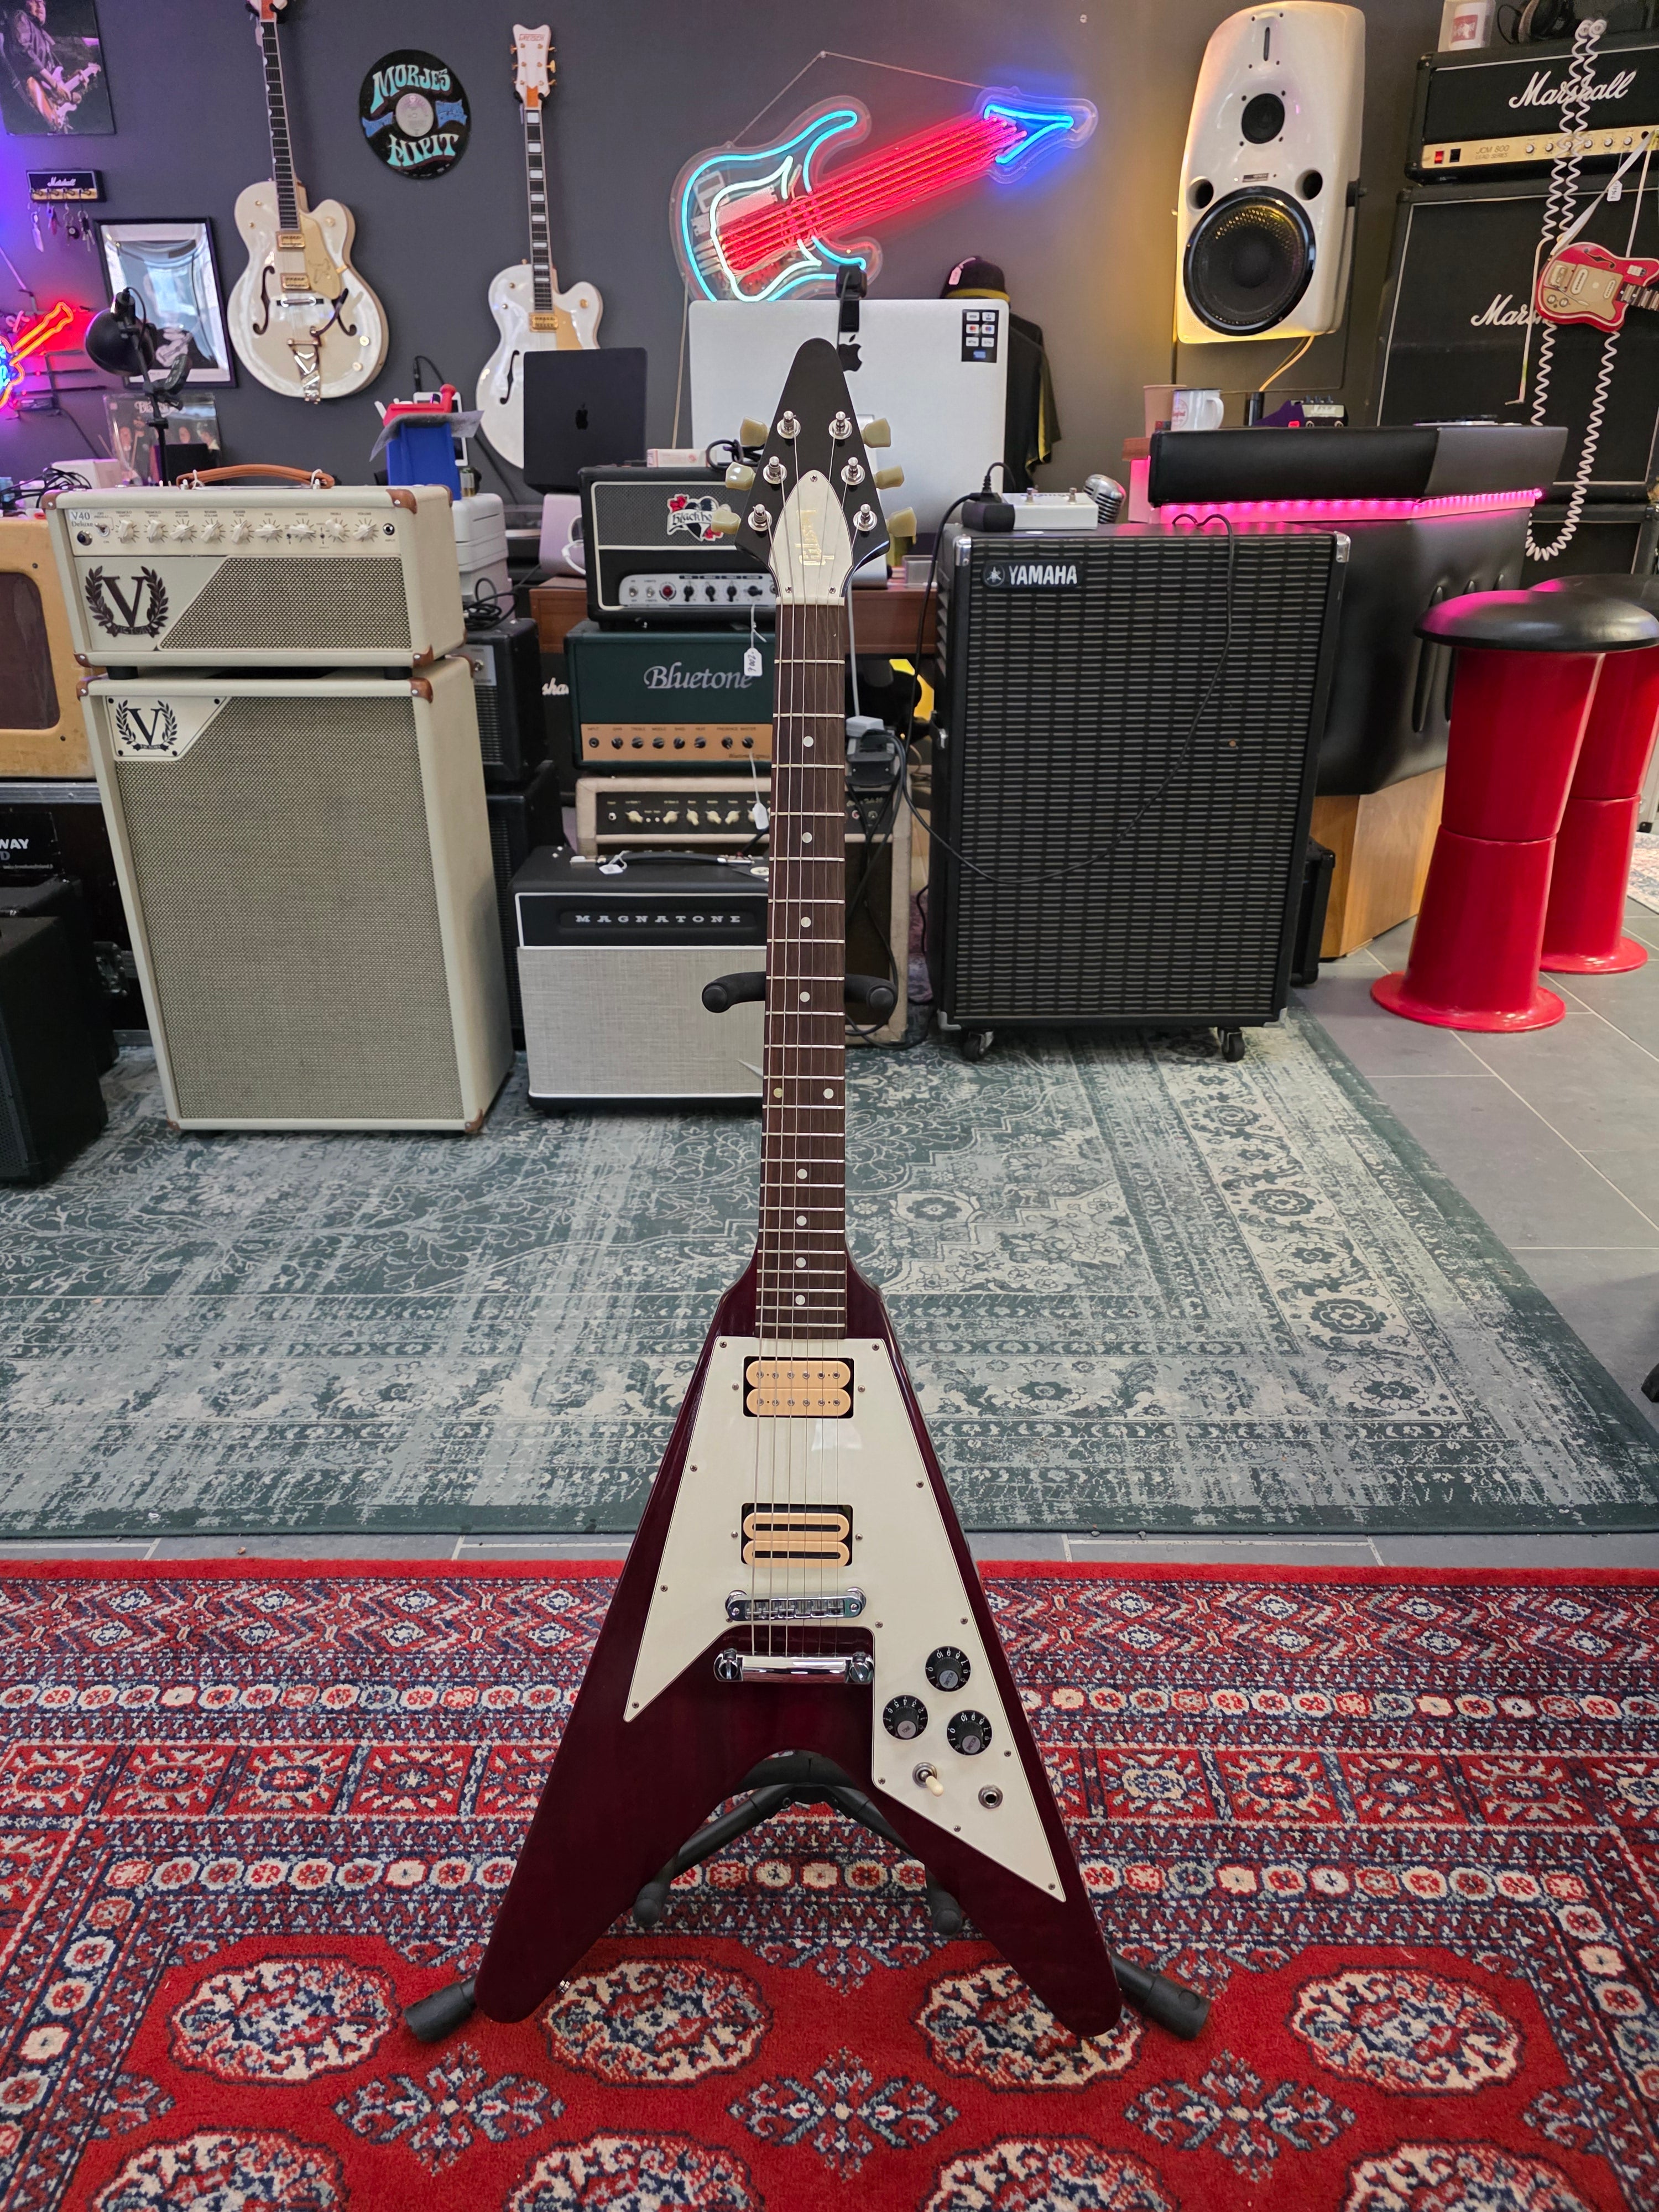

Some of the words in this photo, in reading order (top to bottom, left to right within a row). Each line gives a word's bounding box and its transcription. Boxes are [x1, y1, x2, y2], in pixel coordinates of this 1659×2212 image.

[71, 512, 90, 520] V40
[1009, 565, 1078, 585] YAMAHA
[644, 661, 753, 689] Bluetone
[961, 1714, 968, 1722] 10
